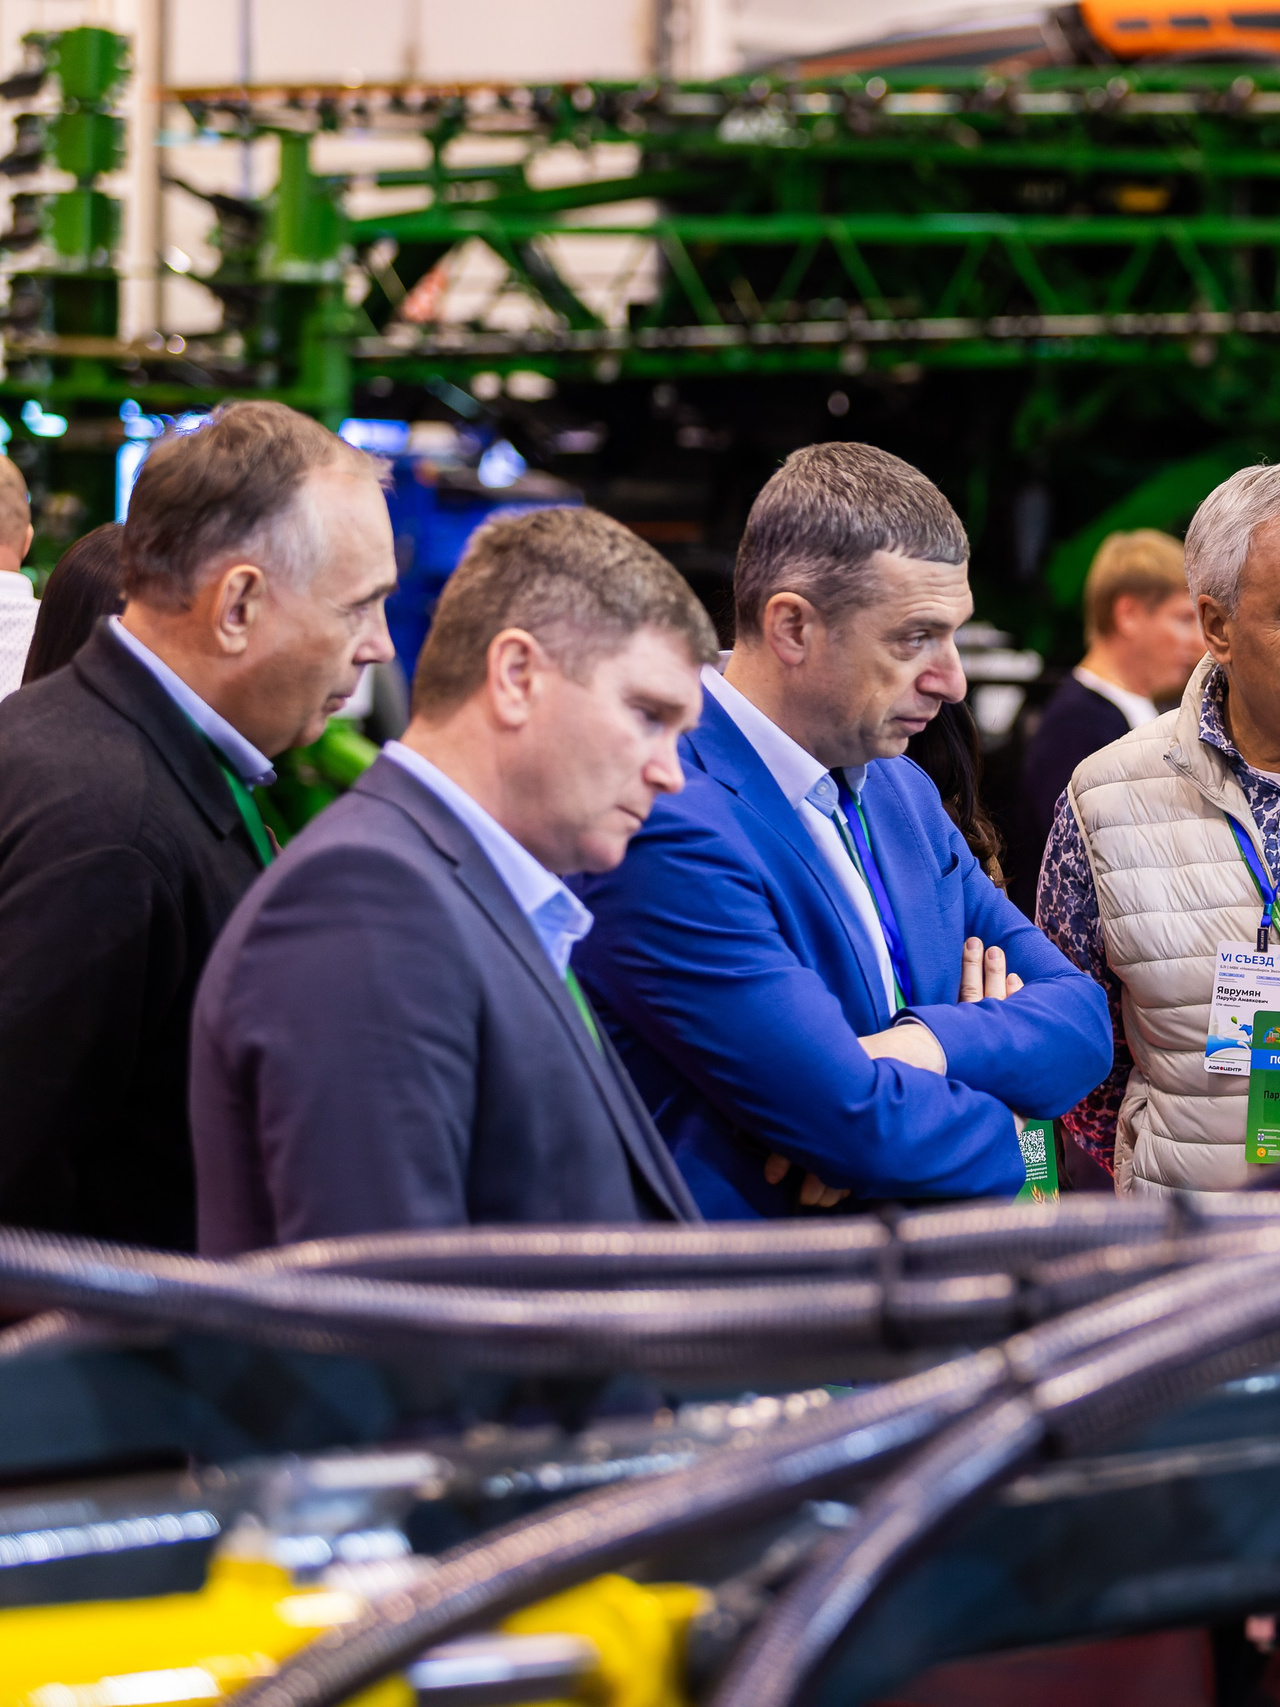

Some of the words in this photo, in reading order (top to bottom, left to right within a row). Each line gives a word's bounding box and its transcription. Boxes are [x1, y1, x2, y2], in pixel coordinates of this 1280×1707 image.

[1221, 953, 1232, 962] VI
[1235, 954, 1275, 967] СЪЕЗД
[1217, 986, 1261, 997] Яврумян
